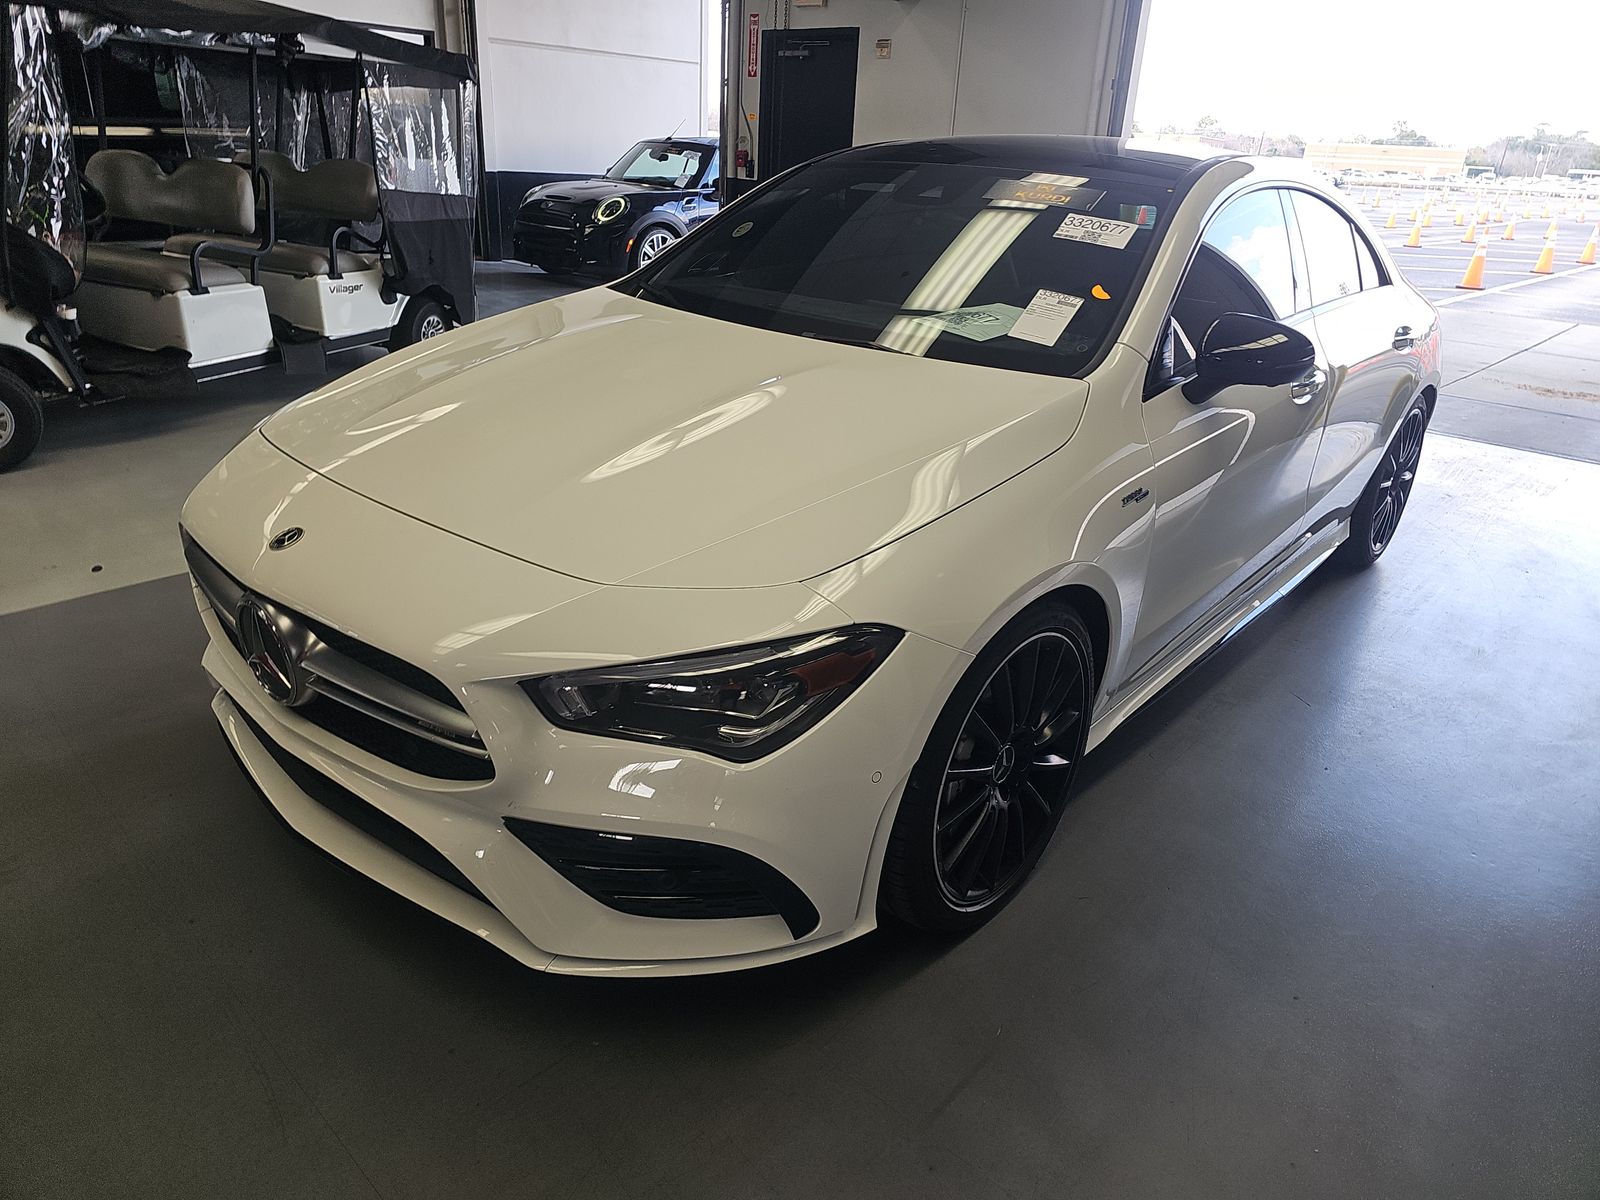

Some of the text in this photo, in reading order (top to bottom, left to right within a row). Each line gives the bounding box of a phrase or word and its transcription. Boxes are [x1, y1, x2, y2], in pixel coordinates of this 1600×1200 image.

[1064, 216, 1130, 235] 3320677
[328, 283, 364, 295] Villager
[1039, 290, 1083, 304] 3320677
